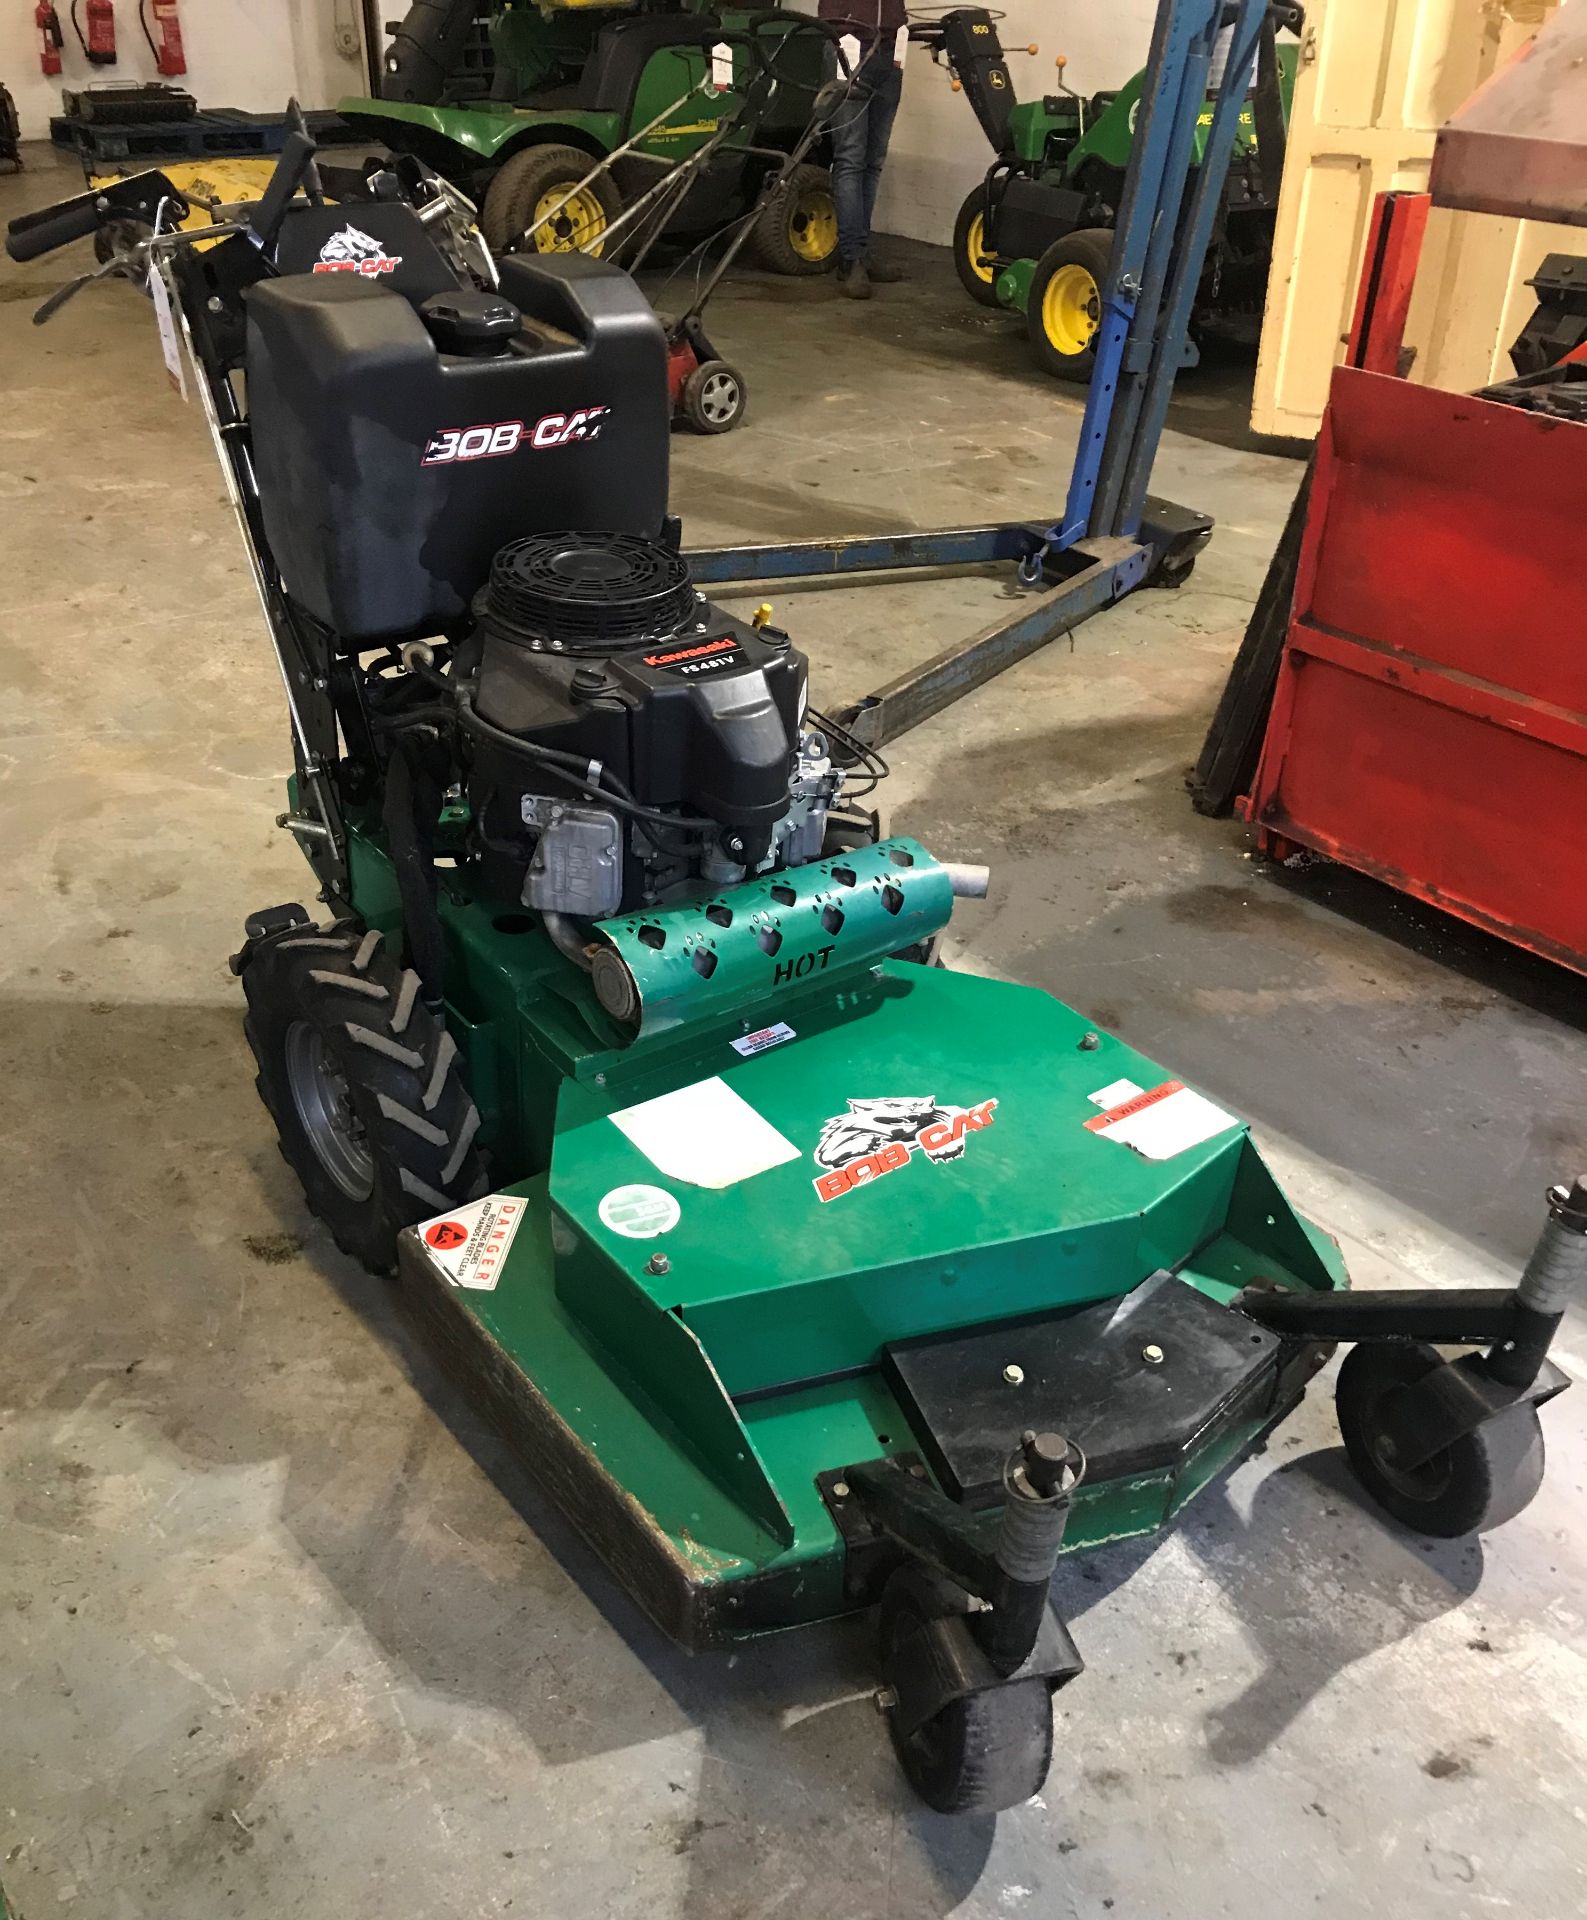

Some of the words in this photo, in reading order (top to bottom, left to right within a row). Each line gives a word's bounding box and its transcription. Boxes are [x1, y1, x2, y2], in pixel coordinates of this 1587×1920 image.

[972, 25, 989, 34] 800
[643, 638, 737, 666] Kawasaki
[681, 655, 735, 674] FS481V
[773, 944, 836, 986] HOT
[1118, 1089, 1169, 1116] WARNING
[812, 1098, 999, 1203] BOB-CAT
[482, 1202, 493, 1216] KEEP
[473, 1216, 487, 1237] HANDS
[480, 1213, 497, 1241] ROTATING
[466, 1243, 475, 1256] FEET
[470, 1242, 485, 1265] BLADES
[475, 1205, 517, 1280] DANGER
[456, 1258, 469, 1276] CLEAR
